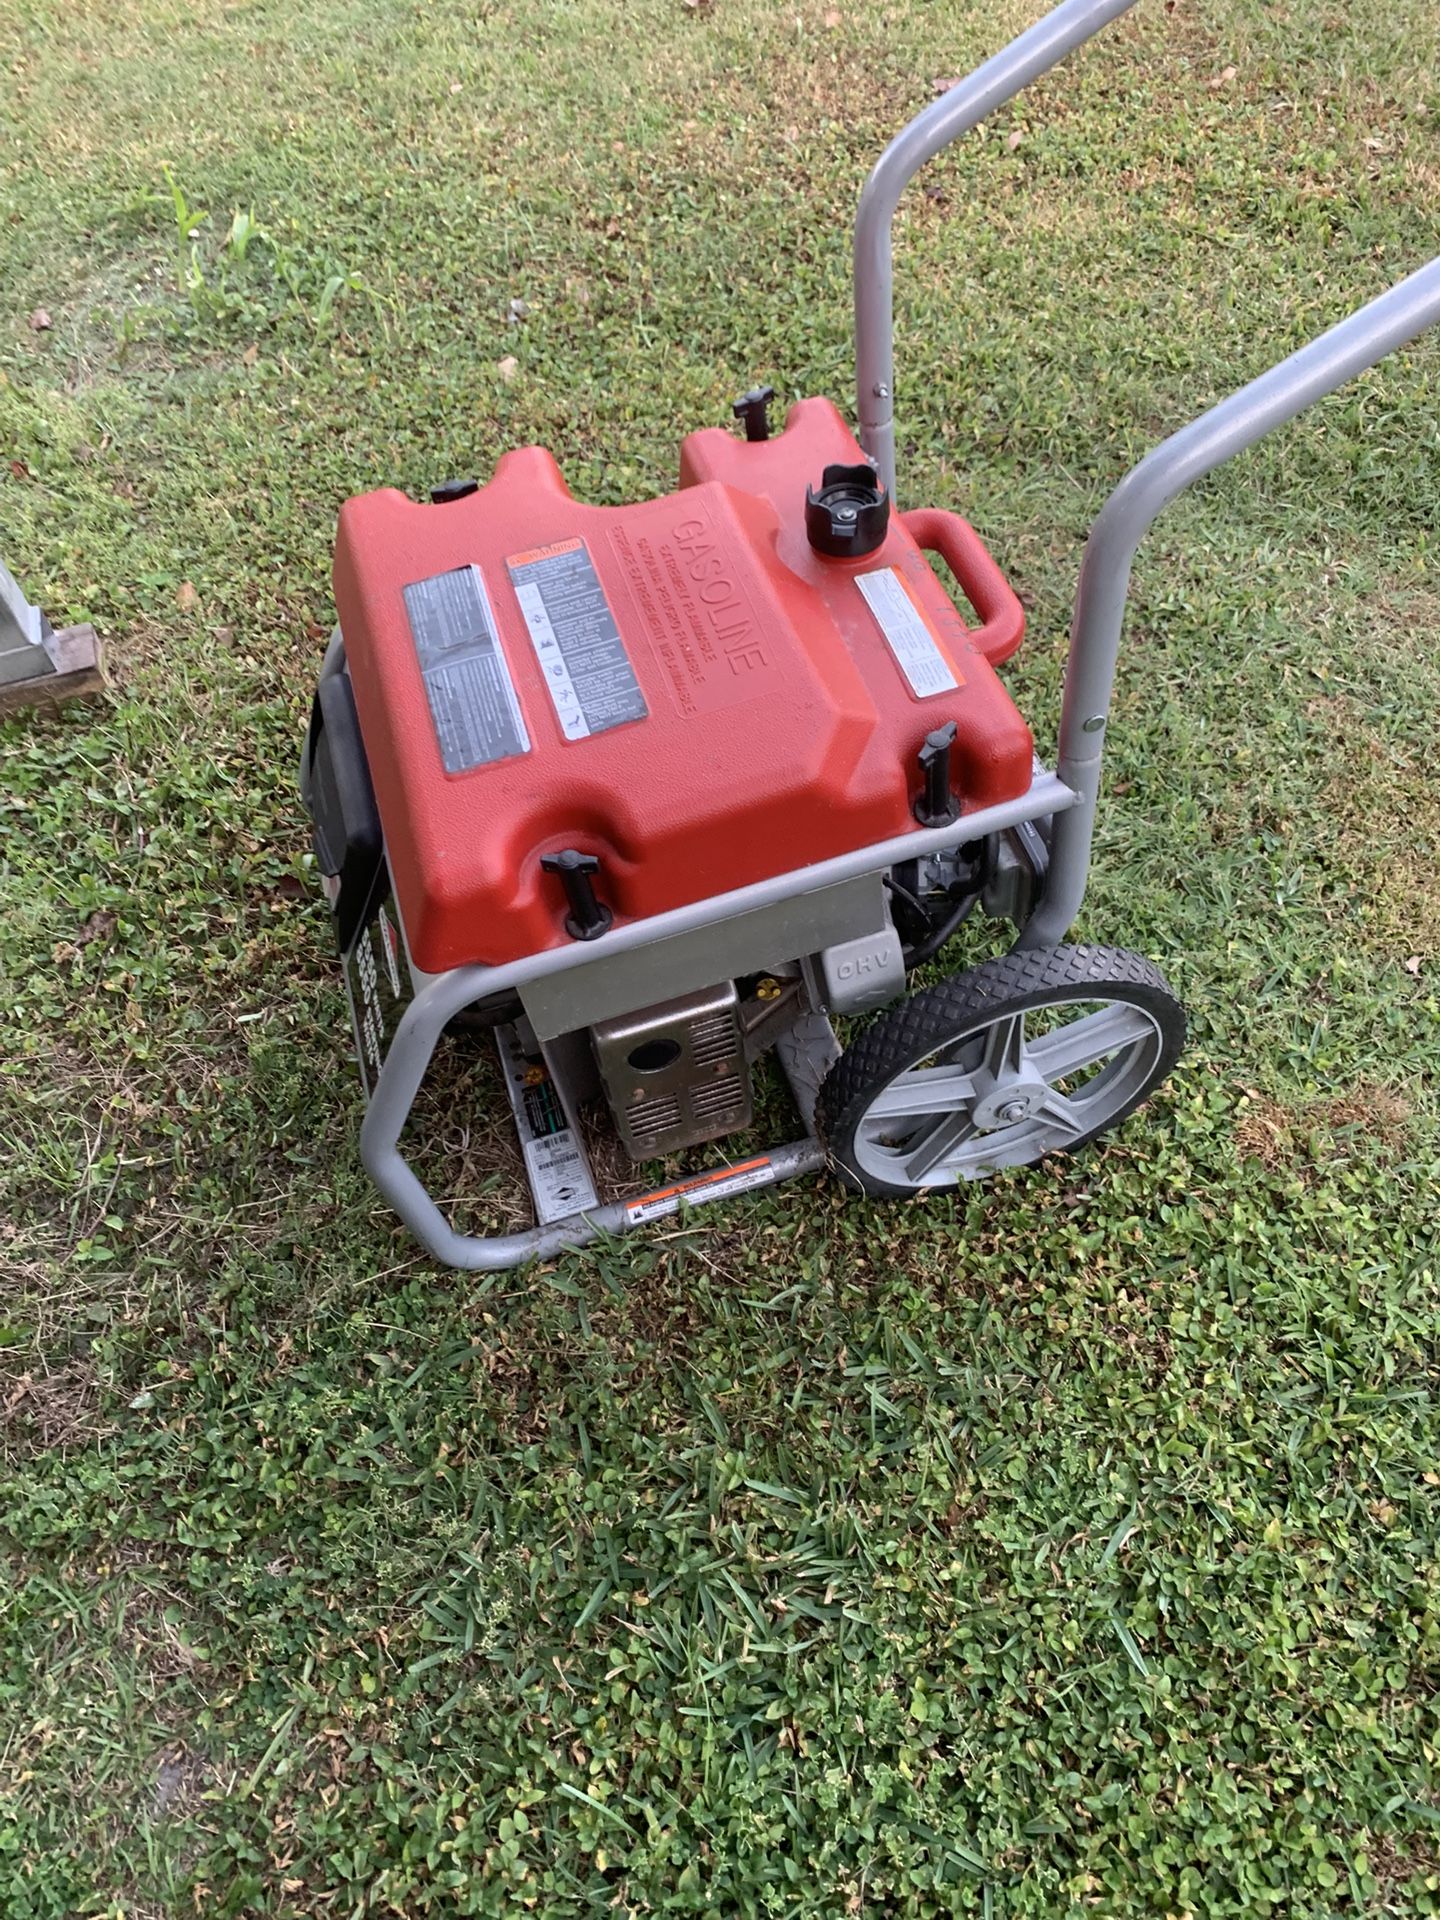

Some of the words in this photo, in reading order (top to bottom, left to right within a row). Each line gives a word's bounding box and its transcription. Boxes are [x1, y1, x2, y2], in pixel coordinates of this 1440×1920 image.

[635, 537, 663, 585] GASOLINA
[655, 585, 682, 630] PELIGRO
[658, 543, 691, 600] EXTREMELY
[682, 601, 717, 663] FLAMMABLE
[671, 519, 768, 677] GASOLINE
[837, 948, 889, 981] OHV
